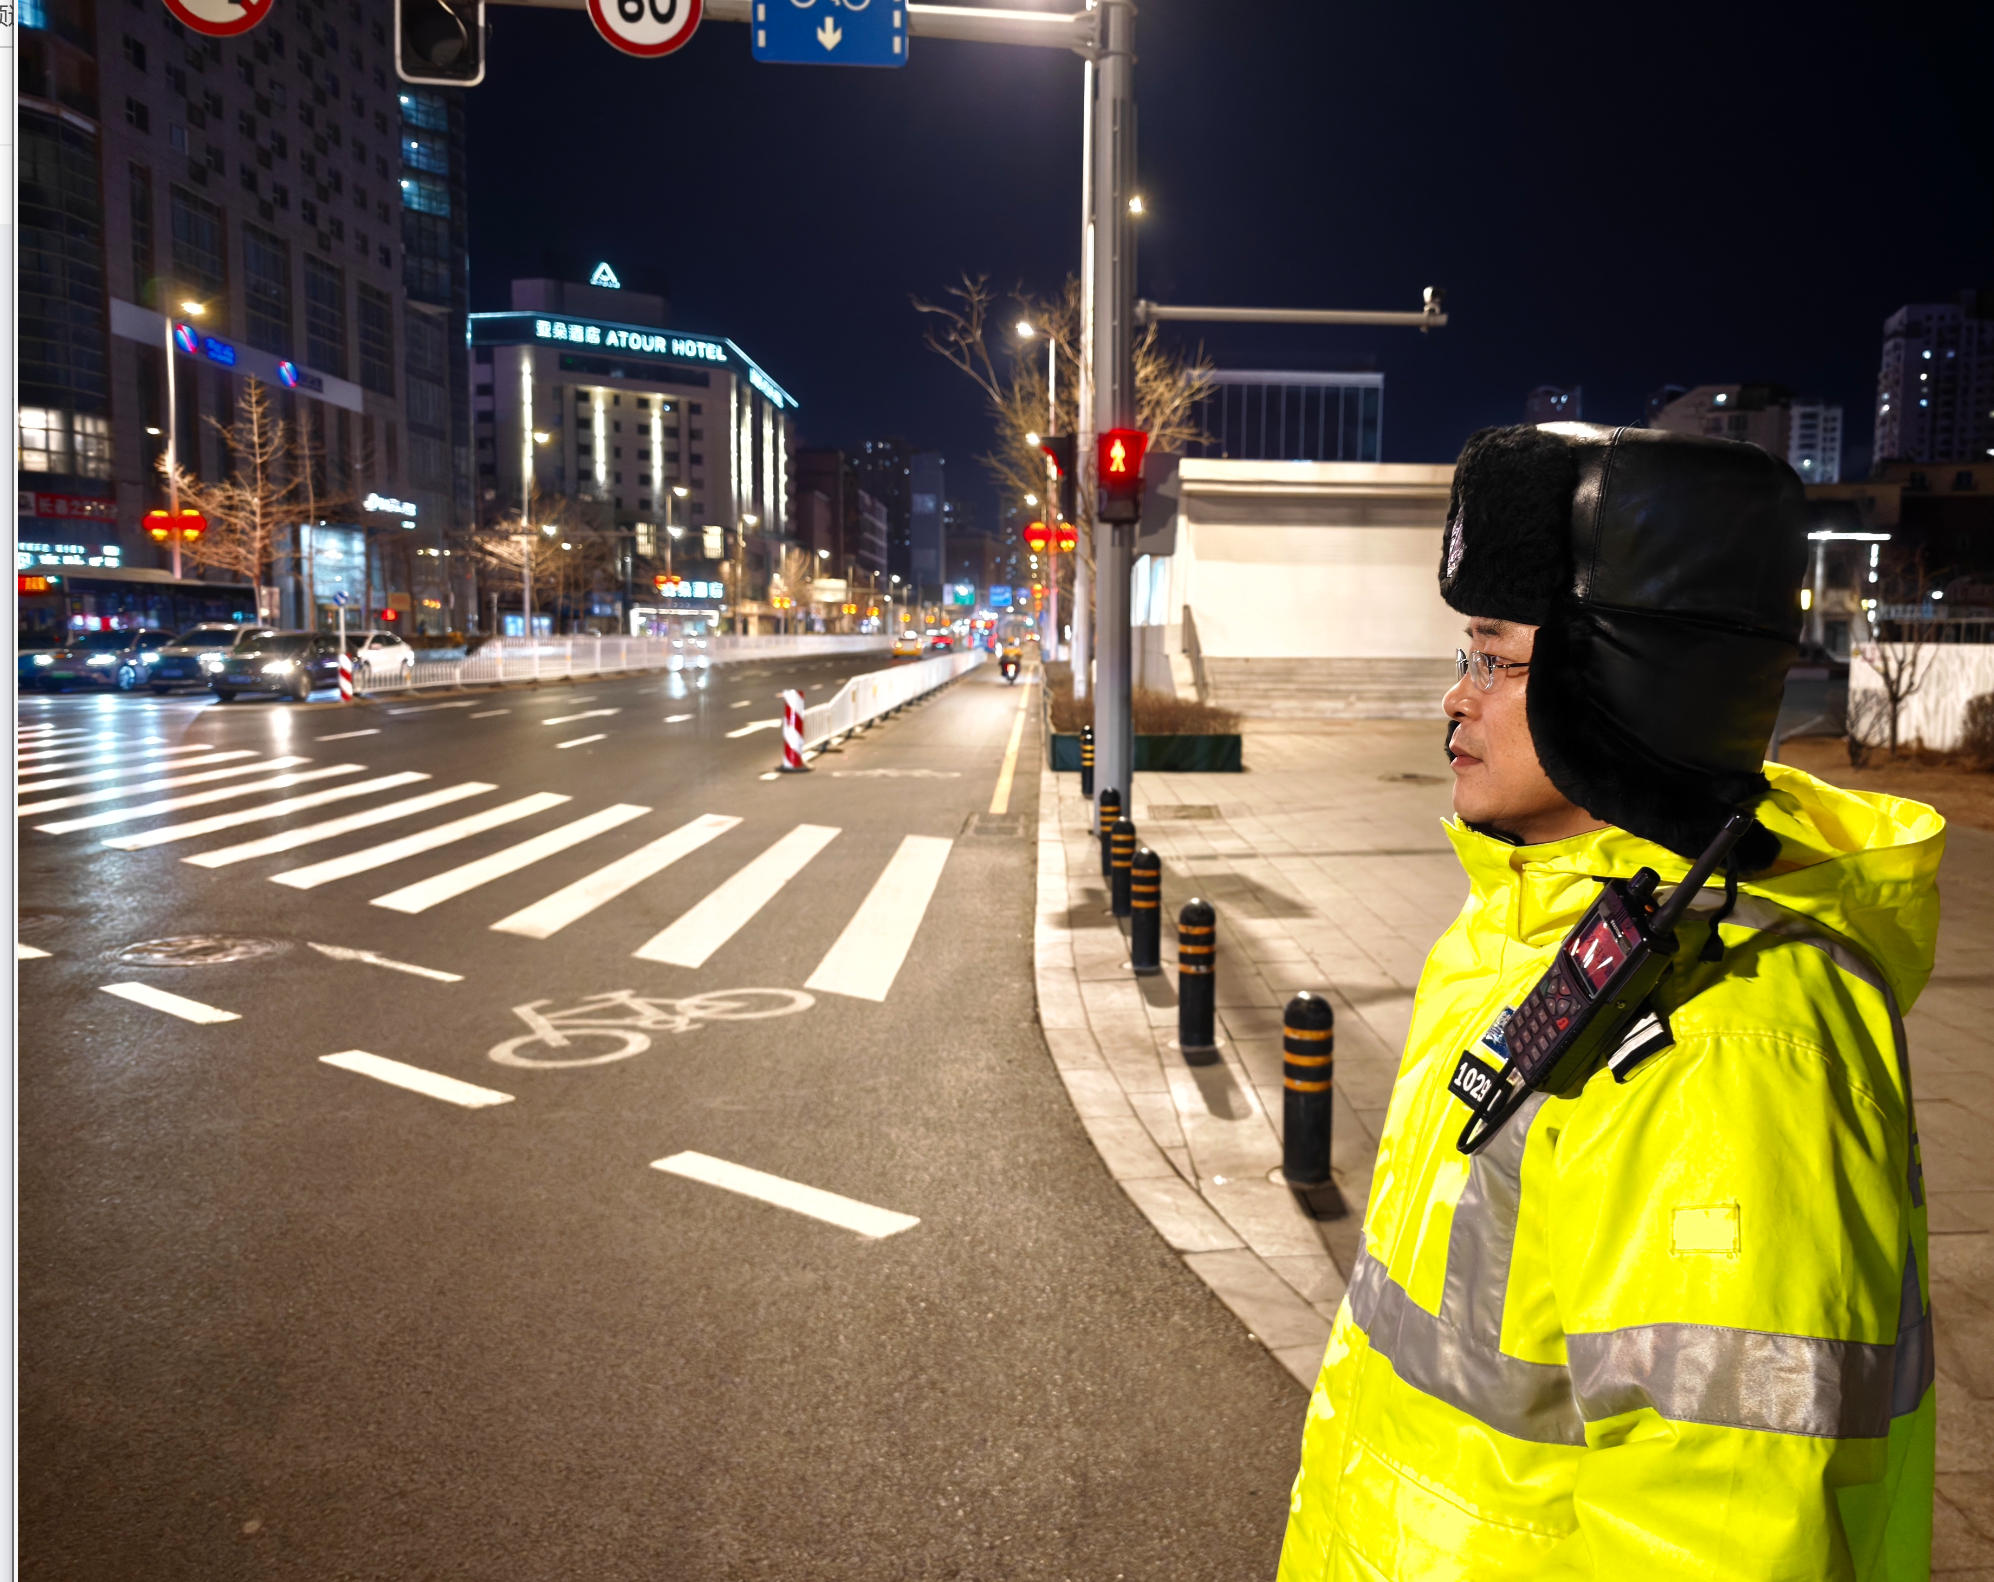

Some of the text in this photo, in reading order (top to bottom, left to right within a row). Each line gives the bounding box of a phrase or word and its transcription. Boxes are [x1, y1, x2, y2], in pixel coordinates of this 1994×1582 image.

[536, 319, 727, 362] 亚朵酒店 ATOUR HOTEL
